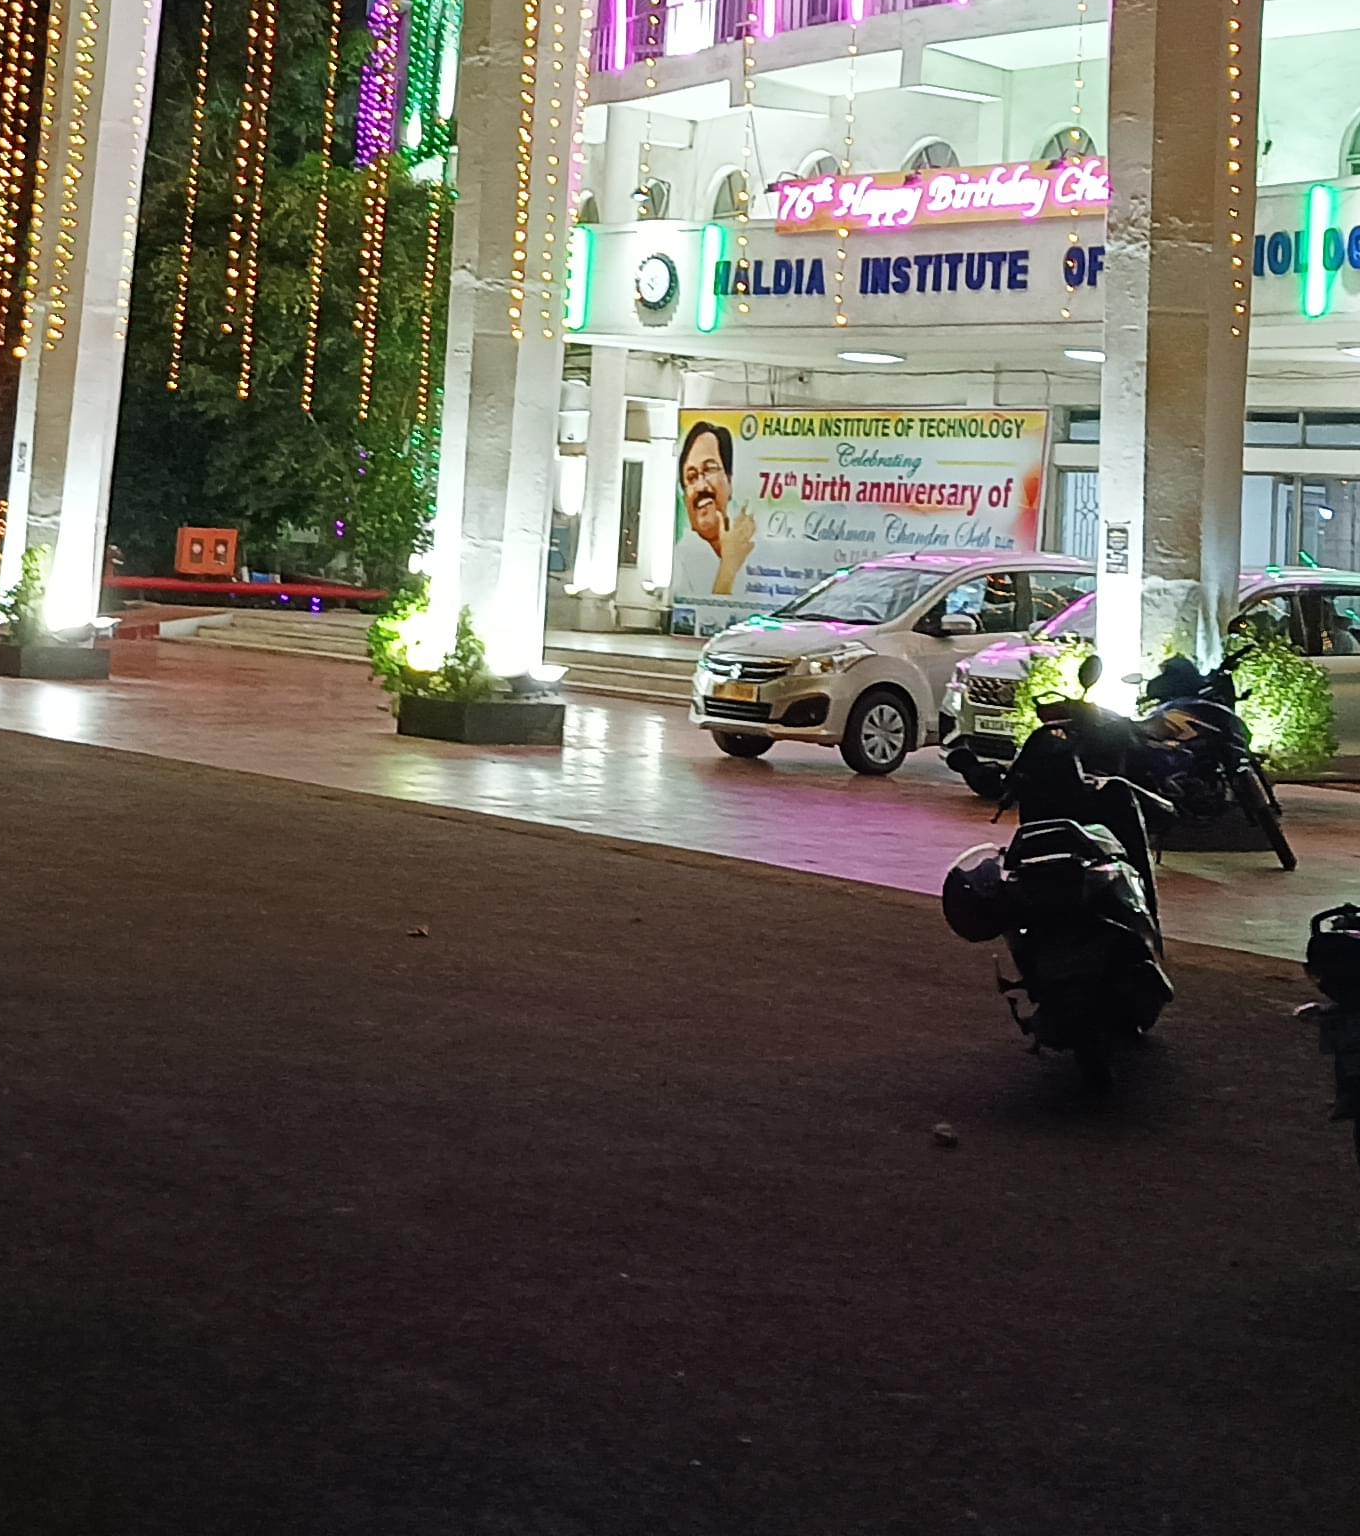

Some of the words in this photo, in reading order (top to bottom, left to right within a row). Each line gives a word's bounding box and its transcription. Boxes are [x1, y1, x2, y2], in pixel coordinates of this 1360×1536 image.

[833, 176, 921, 226] Happy
[926, 165, 1048, 217] Birthday
[713, 258, 826, 296] HALDIA
[859, 250, 1030, 295] INSTITUTE
[1063, 245, 1106, 287] OF
[762, 417, 815, 437] HALDIA
[818, 418, 890, 438] INSTITUTE
[894, 417, 915, 438] OF
[919, 417, 1025, 440] TECHNOLOGY
[836, 442, 924, 478] Celebrating
[759, 470, 798, 500] 76th
[800, 472, 851, 502] birth
[856, 474, 983, 516] anniversary
[988, 477, 1014, 508] of
